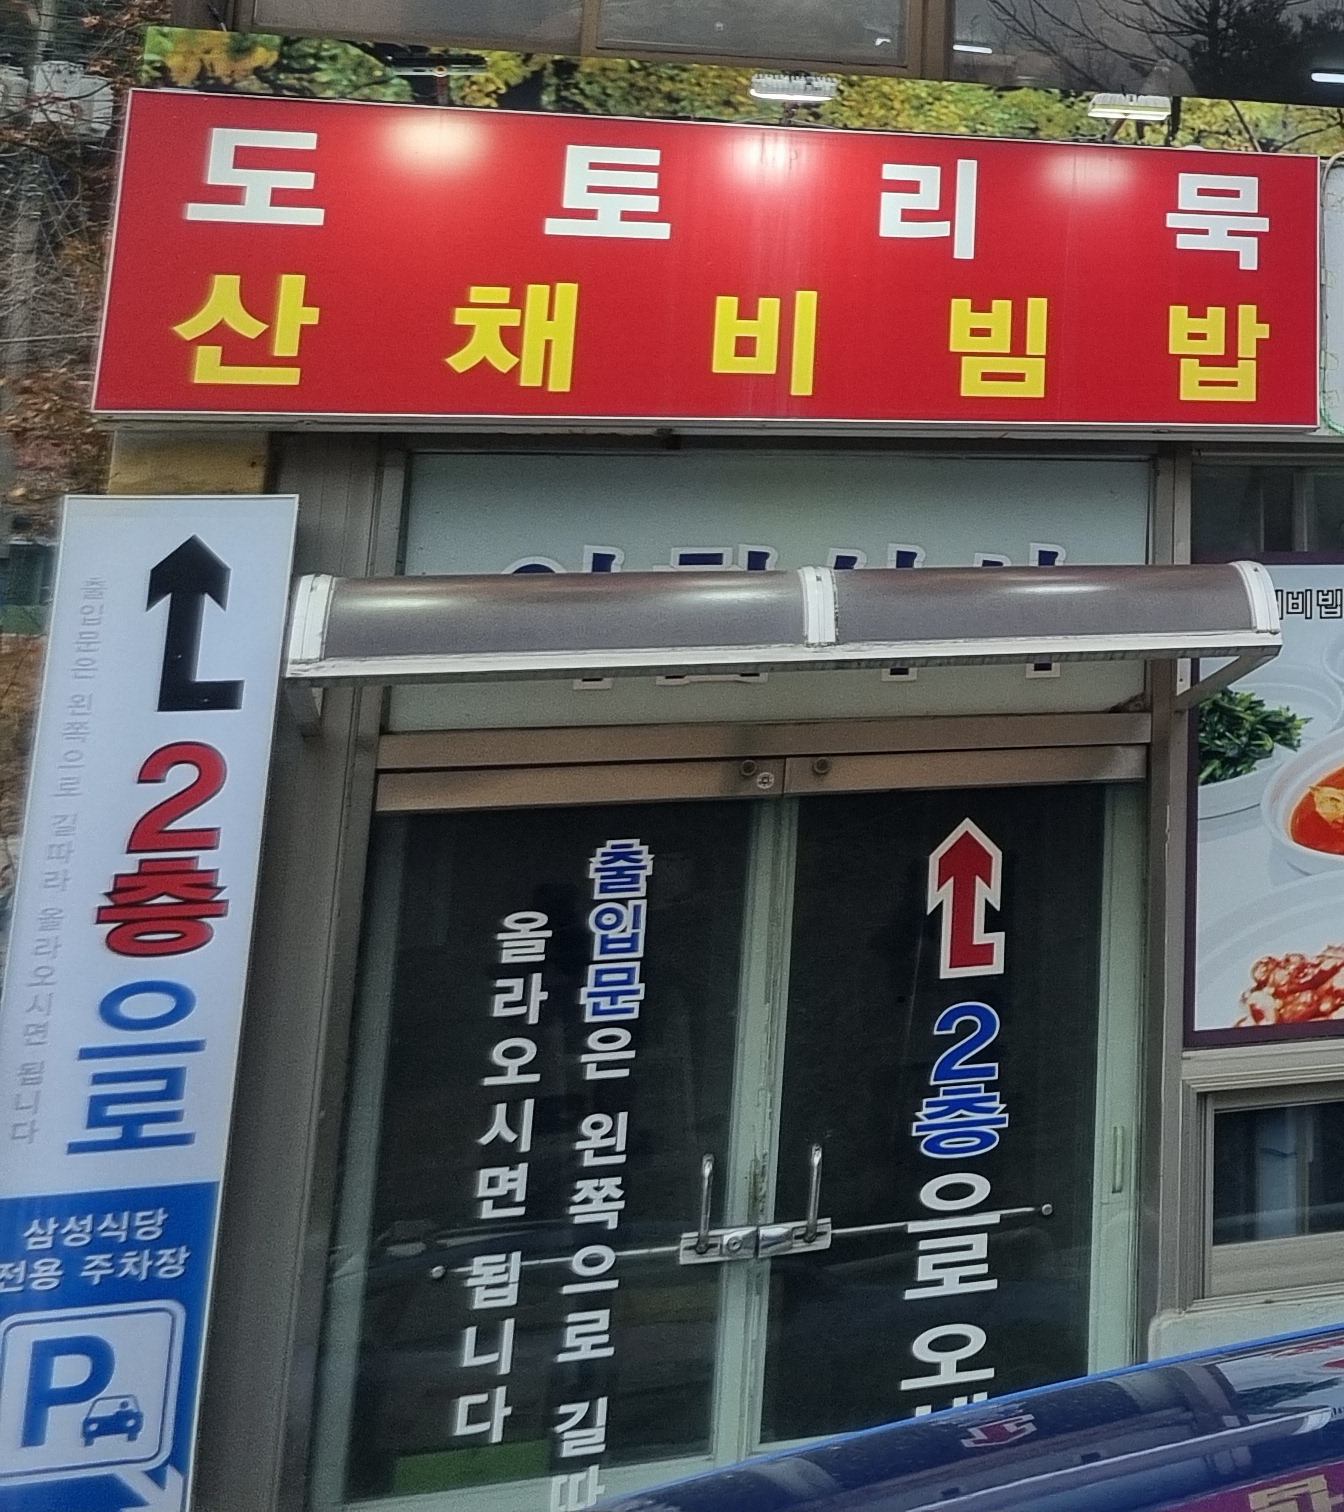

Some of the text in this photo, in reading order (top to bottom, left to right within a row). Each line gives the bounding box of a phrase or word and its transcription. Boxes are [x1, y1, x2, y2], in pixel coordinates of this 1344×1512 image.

[66, 740, 230, 1156] 2층으로
[579, 838, 654, 1083] 출입문은
[0, 1245, 192, 1292] 전용 주차장
[23, 1208, 170, 1251] 삼성식당
[451, 909, 554, 1445] 올라오시면 됩니다
[556, 1111, 629, 1365] 왼쪽으로
[902, 1000, 1010, 1301] 2층으로
